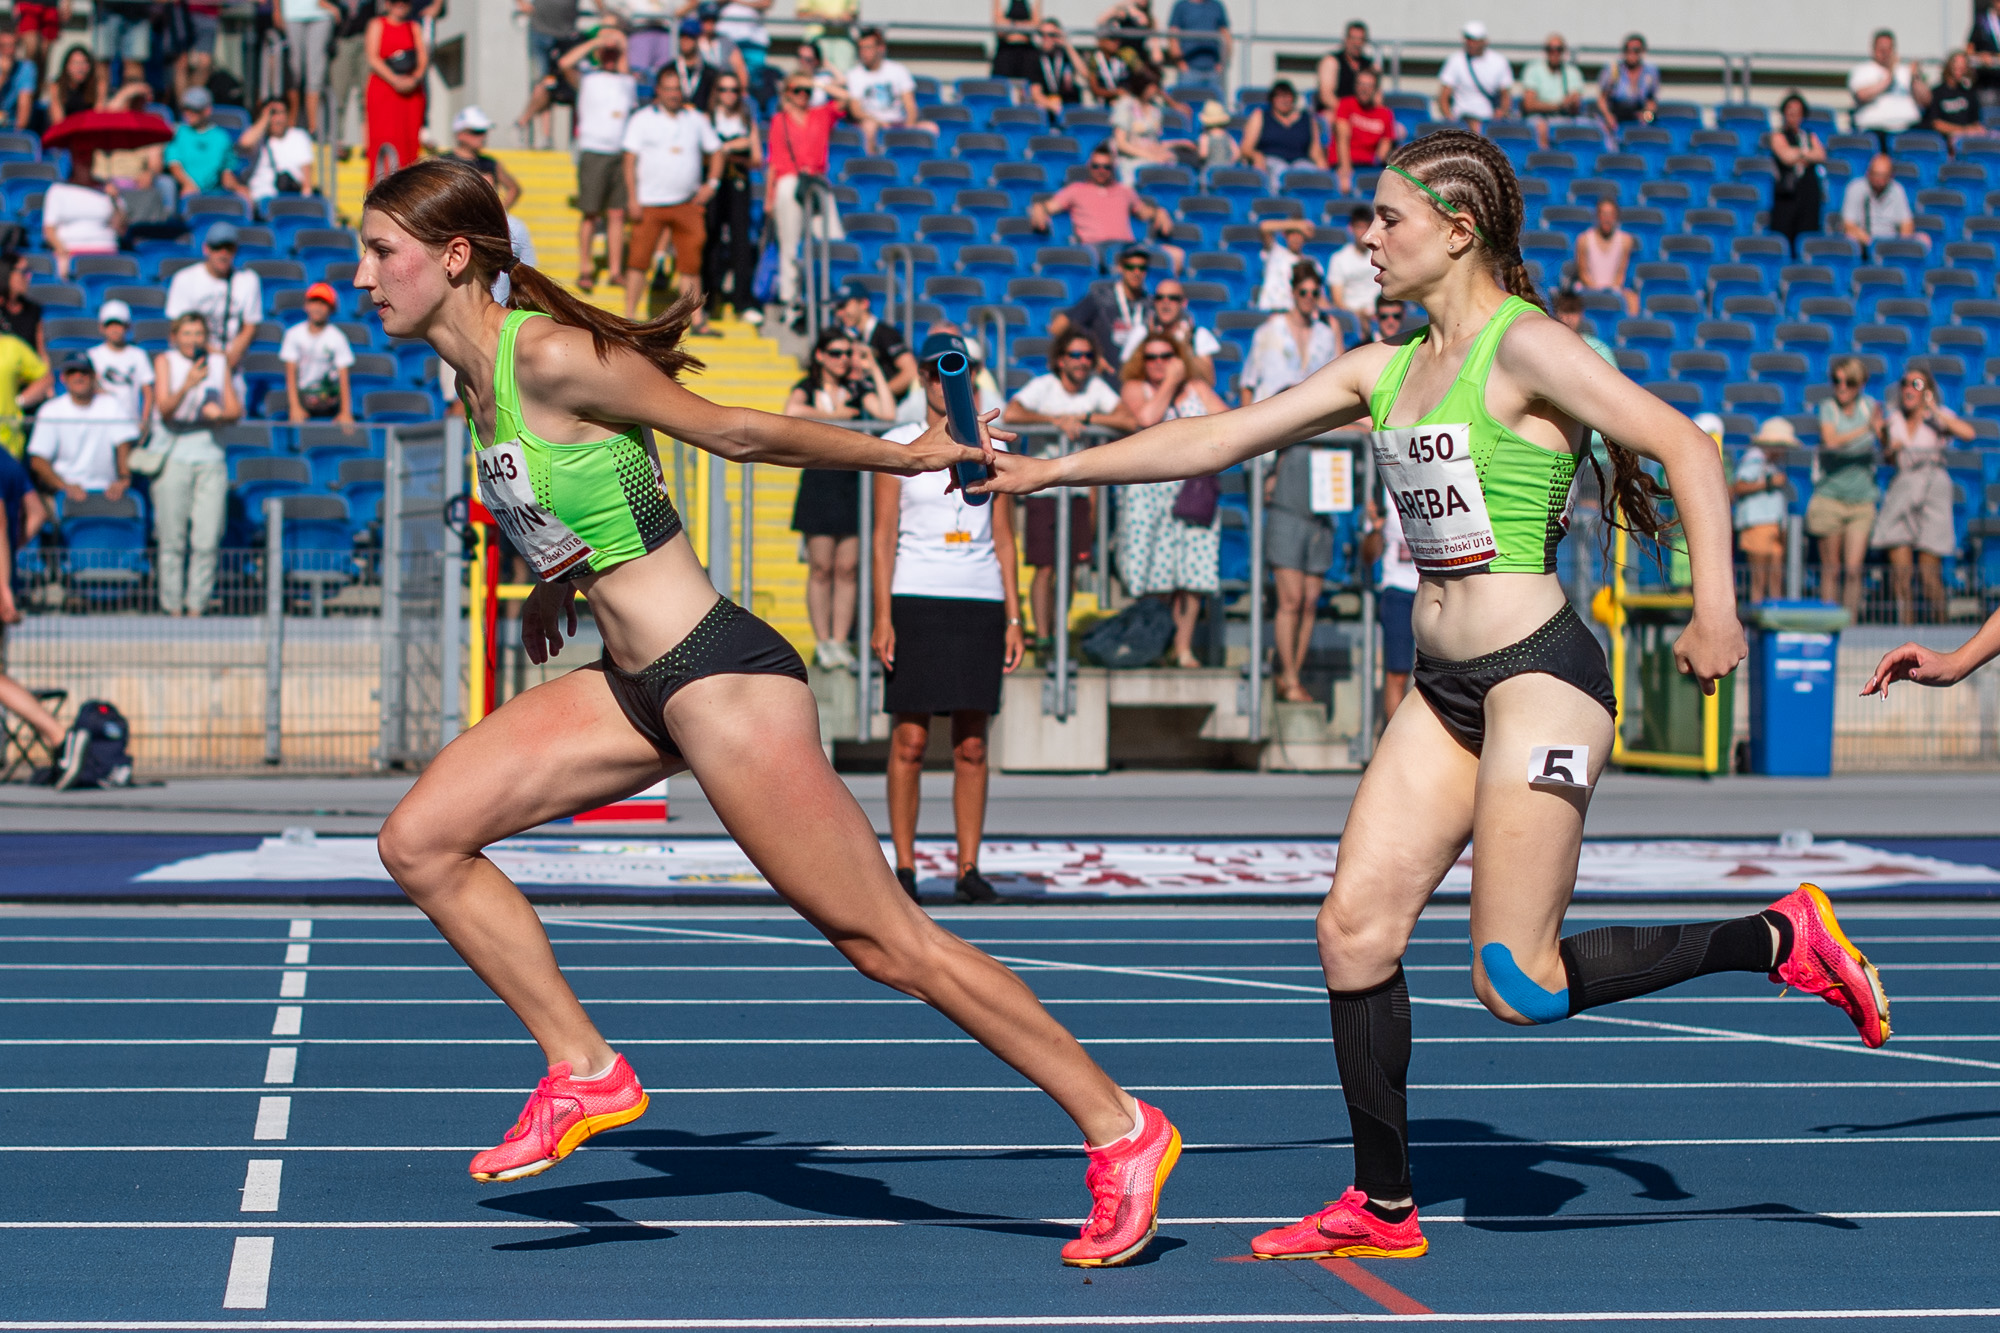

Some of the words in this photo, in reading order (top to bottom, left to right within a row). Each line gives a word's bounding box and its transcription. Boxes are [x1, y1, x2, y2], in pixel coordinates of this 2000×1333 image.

[1408, 432, 1454, 464] 450
[482, 452, 518, 485] 443
[562, 537, 582, 553] U18
[1444, 540, 1472, 554] Polski
[1473, 535, 1493, 549] U18
[1542, 750, 1575, 784] 5
